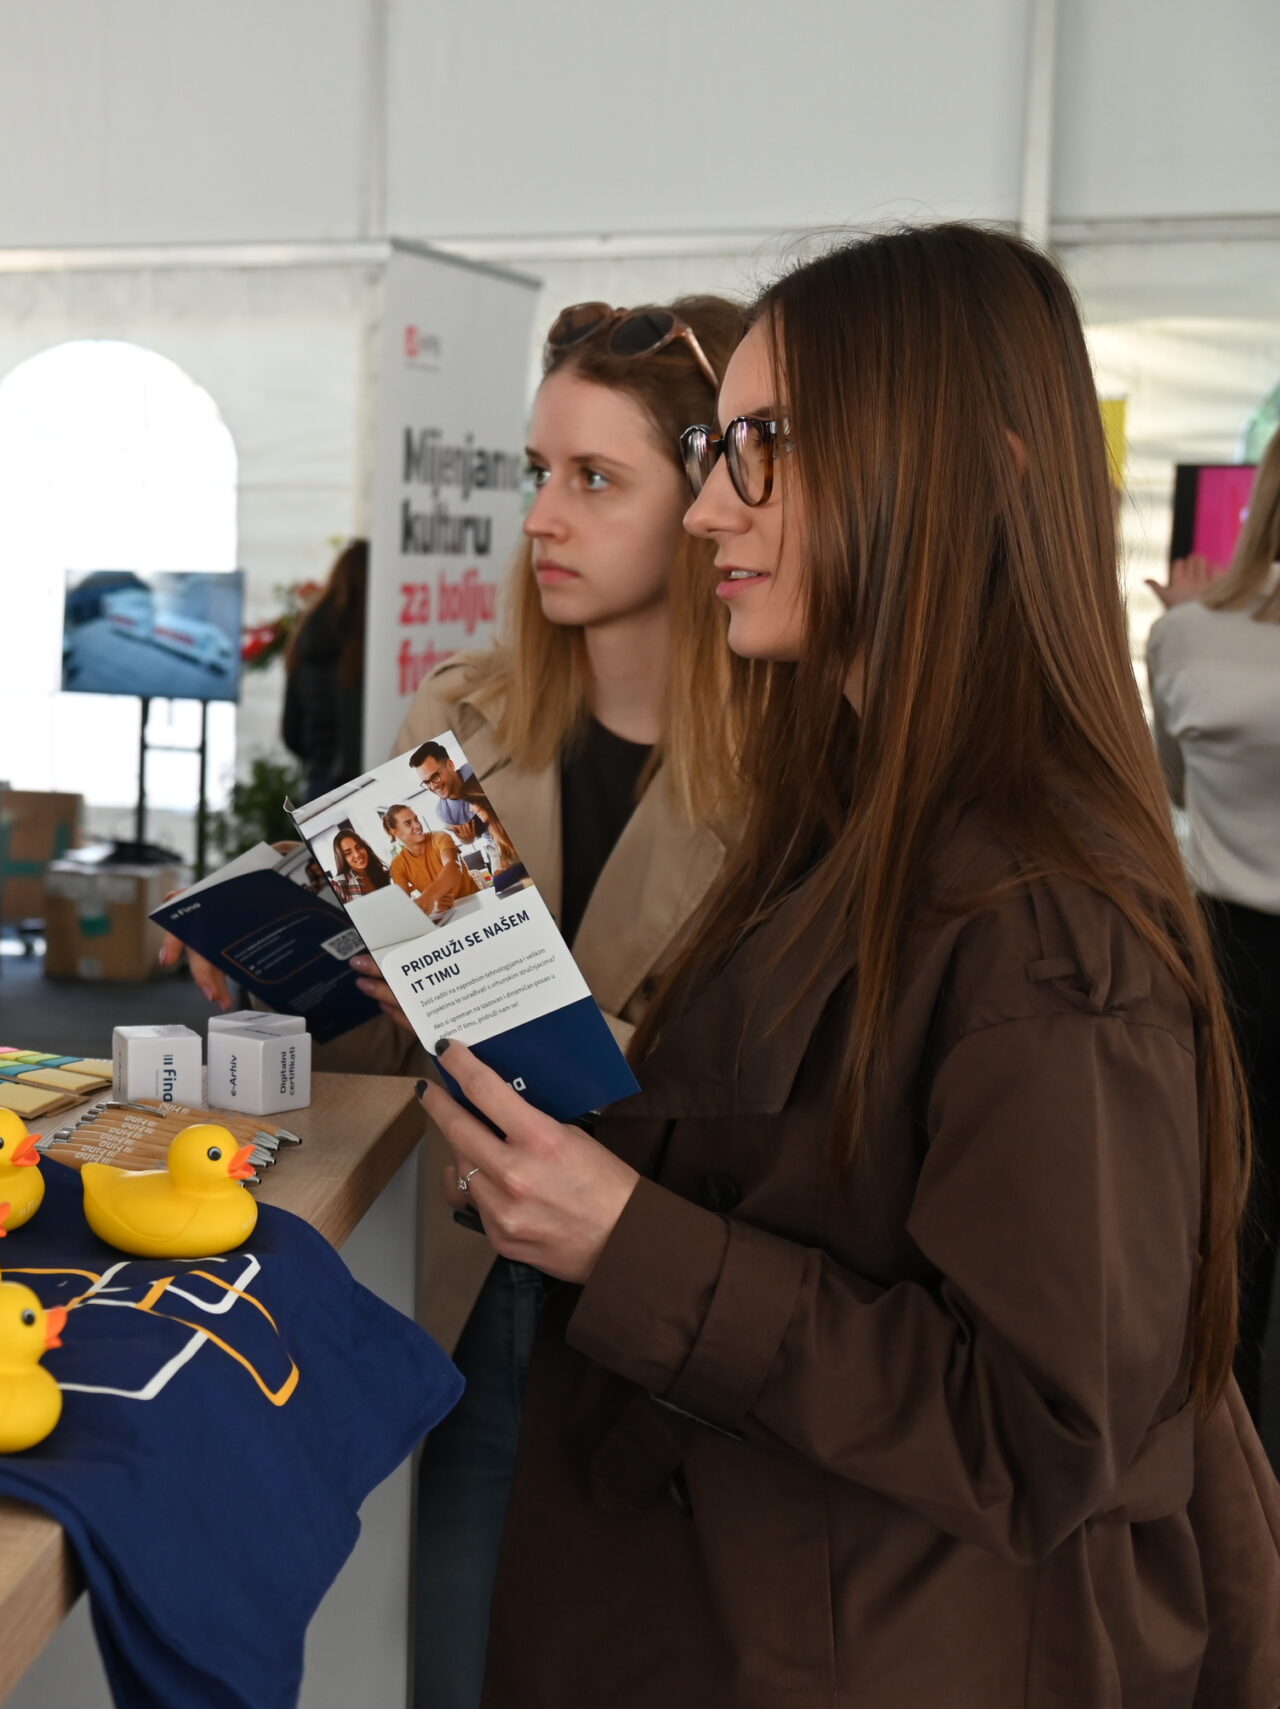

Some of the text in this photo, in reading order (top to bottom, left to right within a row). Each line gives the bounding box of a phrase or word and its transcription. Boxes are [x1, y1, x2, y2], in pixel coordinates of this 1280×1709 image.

[400, 581, 431, 626] za
[401, 910, 530, 976] PRIDRUŽI SE NAŠEM
[410, 963, 460, 994] IT TIMU
[230, 1054, 238, 1097] e-Arhiv
